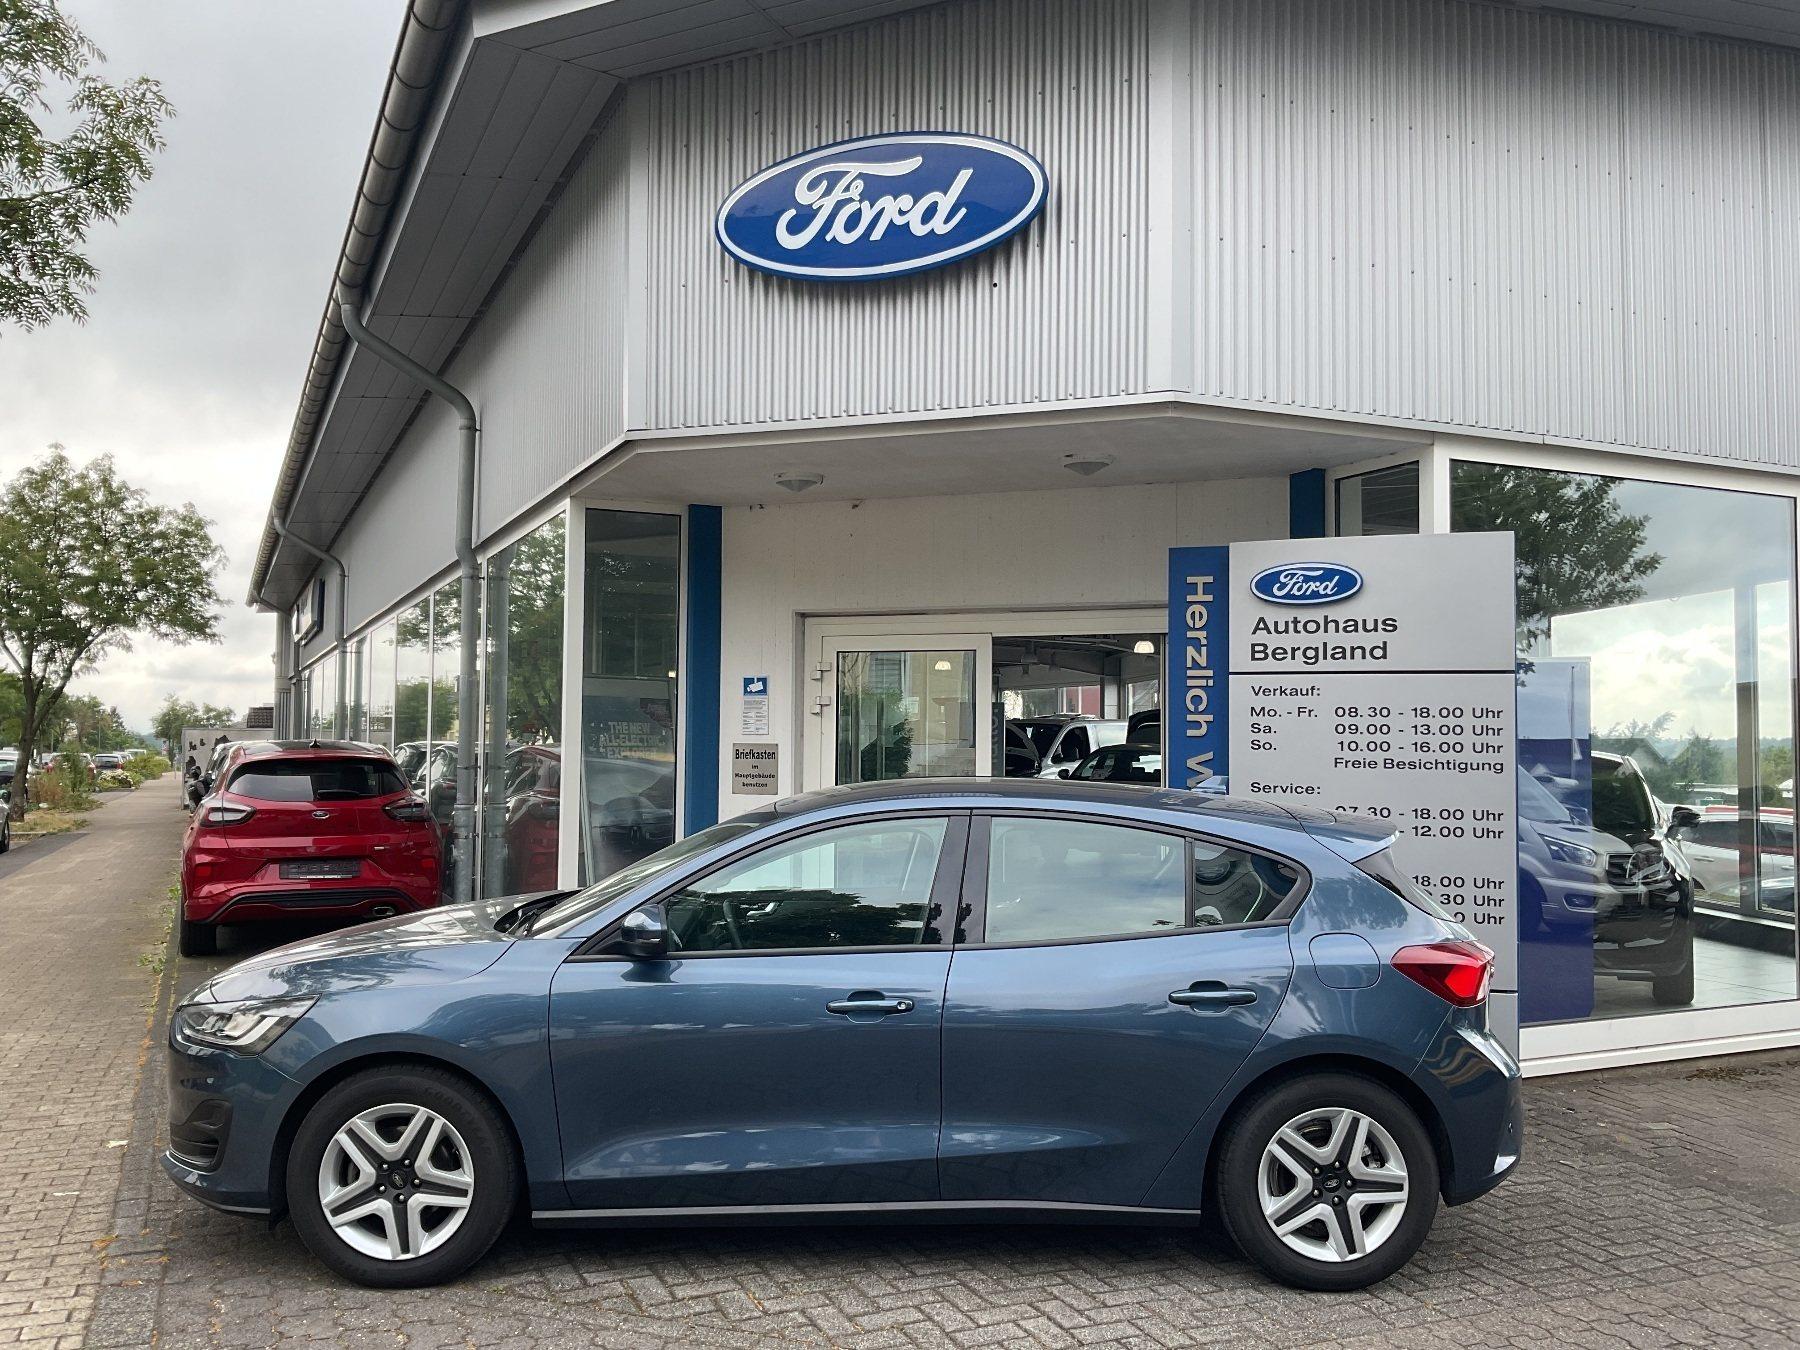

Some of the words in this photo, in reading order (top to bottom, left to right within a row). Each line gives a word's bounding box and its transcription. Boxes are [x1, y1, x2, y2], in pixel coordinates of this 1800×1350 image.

[775, 156, 974, 250] Ford
[1272, 569, 1340, 597] Ford
[1251, 615, 1398, 635] Autohaus
[1185, 575, 1214, 737] Herzlich
[1250, 641, 1388, 666] Bergland
[1251, 685, 1321, 697] Verkauf:
[1250, 706, 1282, 718] Mo.
[1297, 706, 1318, 718] Fr.
[1334, 706, 1391, 718] 08.30
[1411, 706, 1464, 719] 18.00
[1472, 707, 1504, 719] Uhr
[608, 721, 628, 734] THE
[629, 722, 650, 735] NEW
[1250, 722, 1277, 734] Sa.
[1334, 723, 1391, 735] 09.00
[1411, 723, 1464, 736] 13.00
[1472, 724, 1504, 737] Uhr
[735, 748, 776, 760] Briefkasten
[1250, 739, 1277, 751] So.
[1337, 740, 1391, 752] 10.00
[1411, 740, 1464, 753] 16.00
[1472, 741, 1504, 754] Uhr
[1334, 757, 1378, 769] Freie
[1383, 758, 1504, 774] Besichtigung
[1250, 781, 1321, 795] Service:
[1411, 807, 1465, 820] 18.00
[1472, 809, 1504, 822] Uhr
[1411, 825, 1465, 838] 12.00
[1472, 826, 1504, 839] Uhr
[1412, 875, 1465, 888] 18.00
[1473, 877, 1505, 890] Uhr
[1473, 894, 1505, 907] Uhr
[1473, 912, 1505, 925] Uhr
